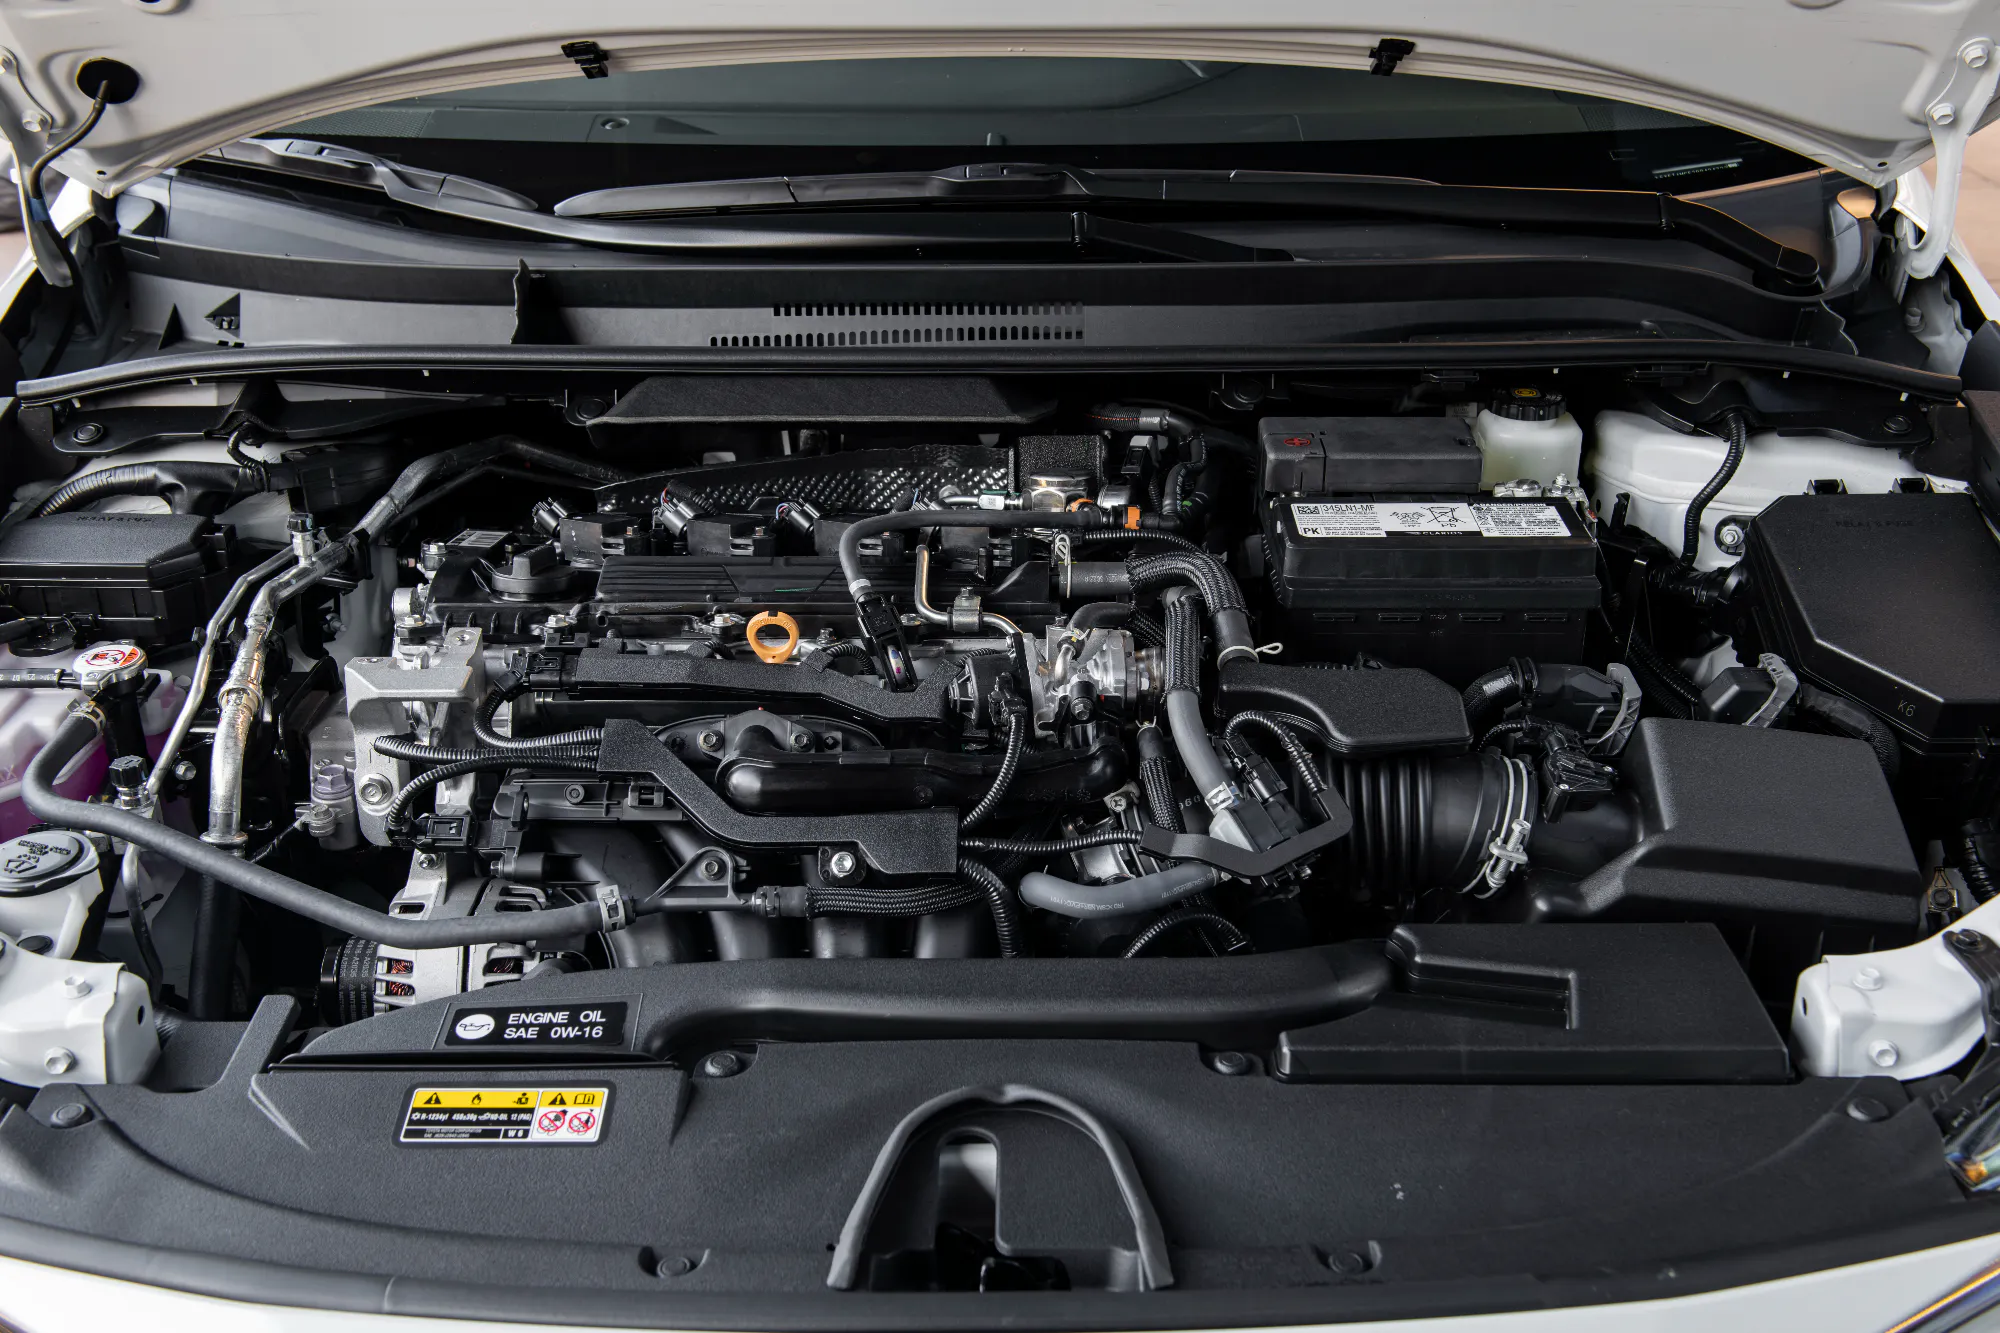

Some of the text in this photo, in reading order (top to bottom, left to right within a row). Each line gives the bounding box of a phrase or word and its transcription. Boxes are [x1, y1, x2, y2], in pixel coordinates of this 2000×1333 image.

[1323, 504, 1375, 512] 345LN1-MF
[1303, 527, 1321, 535] PK
[507, 1010, 606, 1025] ENGINE OIL
[503, 1025, 603, 1039] SAE 0W-16
